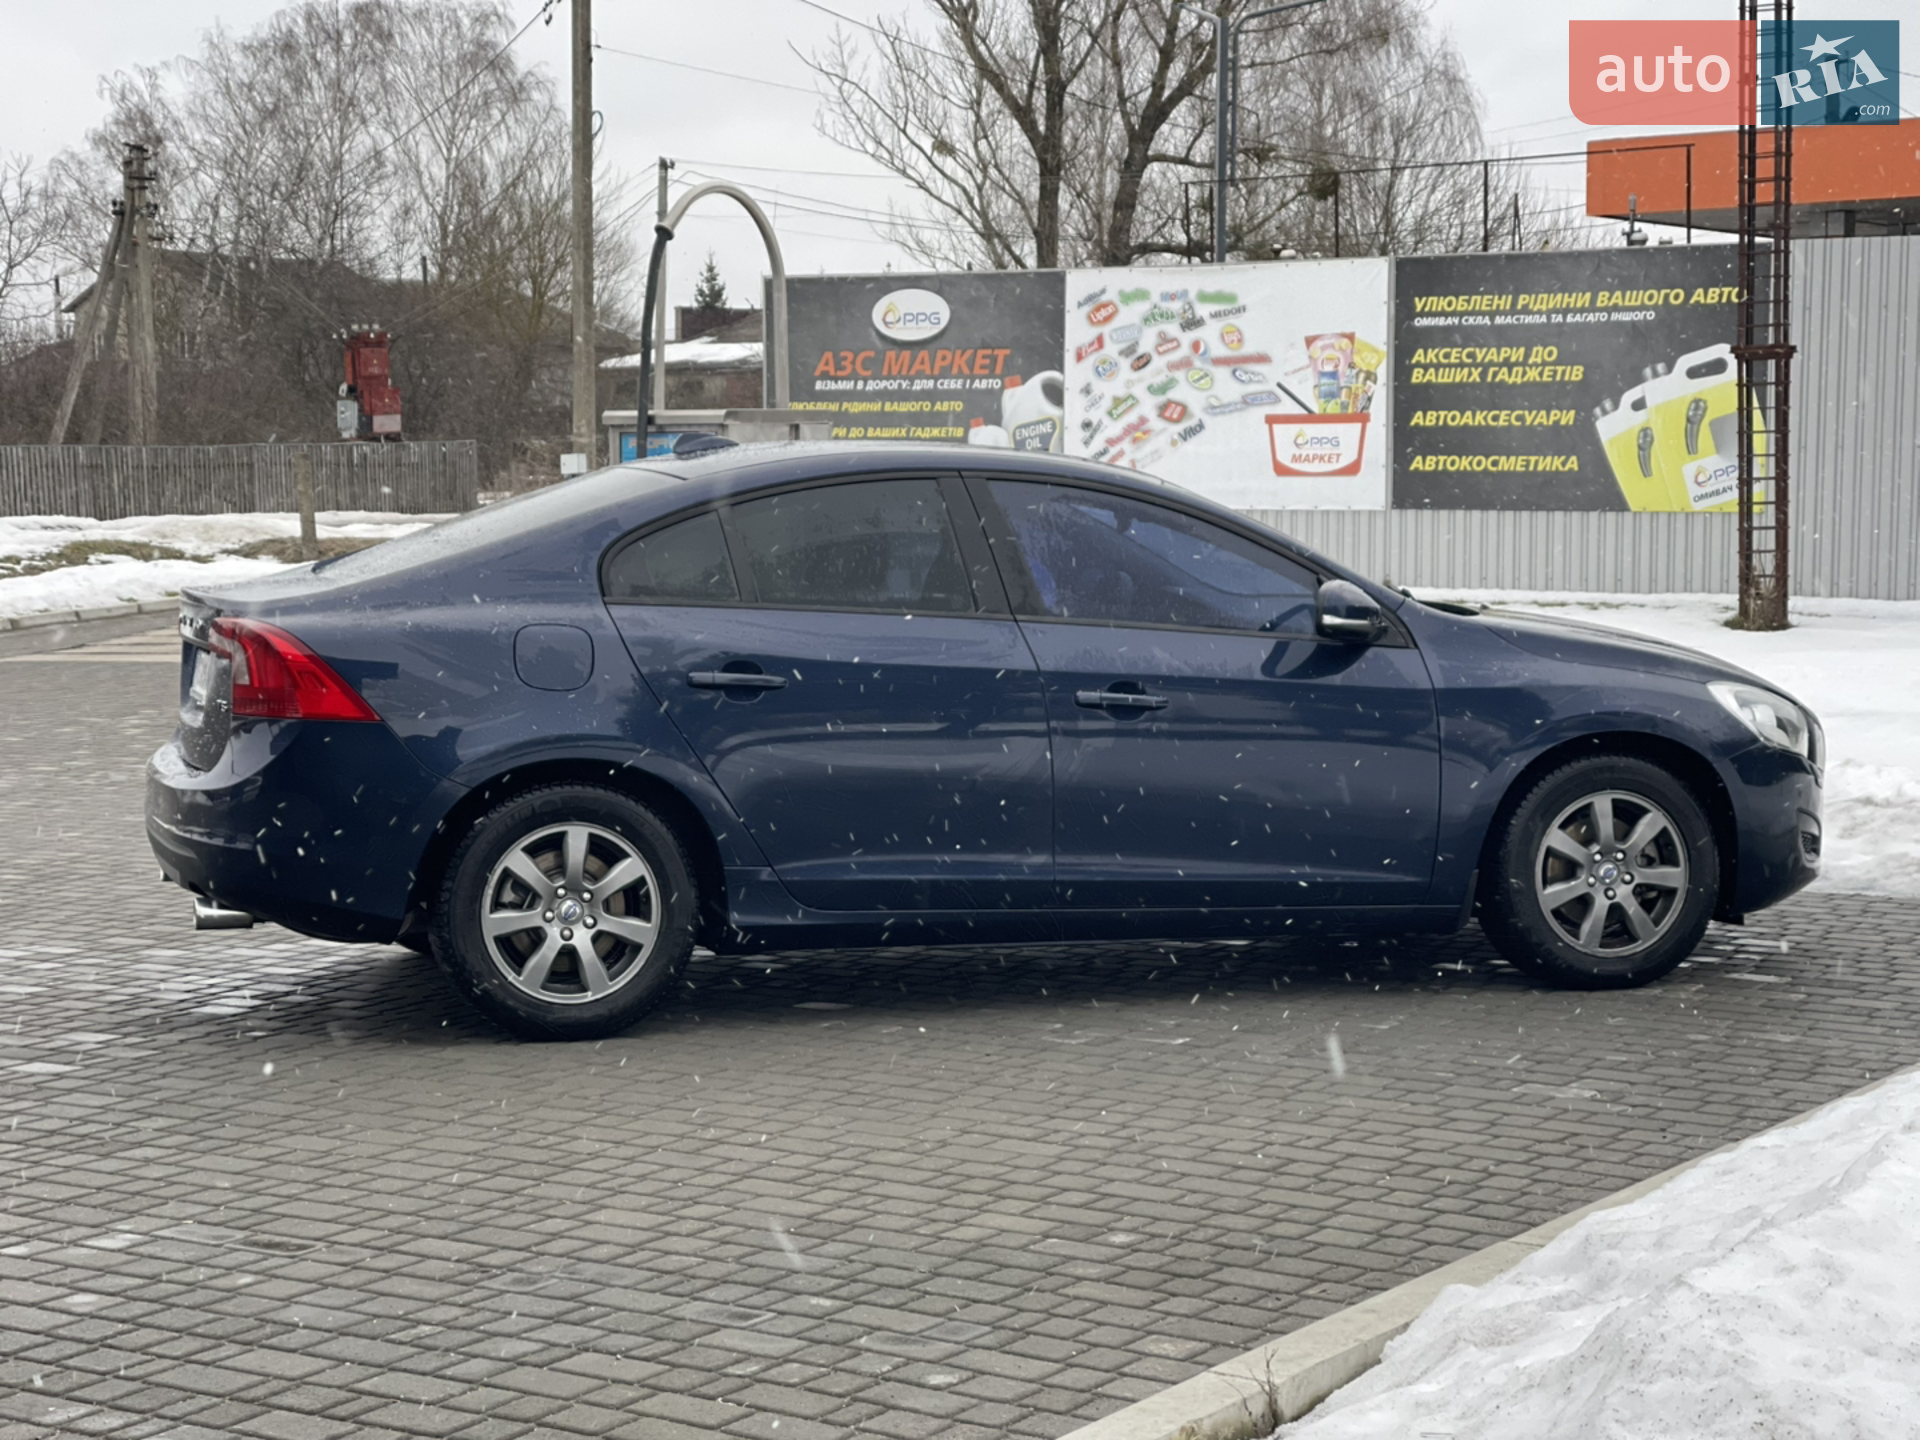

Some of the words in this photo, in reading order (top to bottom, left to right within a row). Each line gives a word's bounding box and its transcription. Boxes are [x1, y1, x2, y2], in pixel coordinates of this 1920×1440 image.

[1414, 294, 1513, 312] УЛЮБЛЕНІ
[1516, 291, 1592, 311] РІДИНИ
[1596, 288, 1685, 308] ВАШОГО
[904, 312, 941, 326] PPG
[1209, 304, 1247, 320] MEDOFF
[1414, 316, 1459, 327] ОМИВАЧ
[1494, 314, 1547, 325] МАСТИЛА
[1550, 313, 1564, 324] ТА
[1566, 312, 1608, 323] БАГАТО
[1610, 310, 1656, 322] ІНШОГО
[814, 350, 876, 376] АЗС
[881, 349, 1011, 376] МАРКЕТ
[1411, 347, 1526, 364] АКСЕСУАРИ
[1528, 346, 1558, 365] ДО
[1411, 366, 1483, 383] ВАШИХ
[1486, 365, 1585, 384] ГАДЖЕТІВ
[815, 379, 854, 390] ВІЗЬМИ
[856, 379, 864, 390] В
[865, 379, 911, 391] ДОРОГУ:
[912, 379, 934, 391] ДЛЯ
[936, 379, 963, 390] СЕБЕ
[972, 378, 1001, 390] АВТО
[841, 402, 883, 413] РІДИНИ
[884, 401, 931, 412] ВАШОГО
[933, 401, 963, 411] АВТО
[1409, 409, 1576, 427] АВТОАКСЕСУАРИ
[849, 427, 865, 438] ДО
[867, 427, 907, 438] ВАШИХ
[909, 427, 964, 438] ГАДЖЕТІВ
[1015, 421, 1053, 440] ENGINE
[1178, 418, 1206, 442] Vitol
[1025, 437, 1043, 450] OIL
[1310, 436, 1340, 448] PPG
[1291, 453, 1342, 464] МАРКЕТ
[1409, 455, 1579, 472] АВТОКОСМЕТИКА
[1713, 464, 1739, 481] PP
[1693, 484, 1733, 503] ОМИВАЧ
